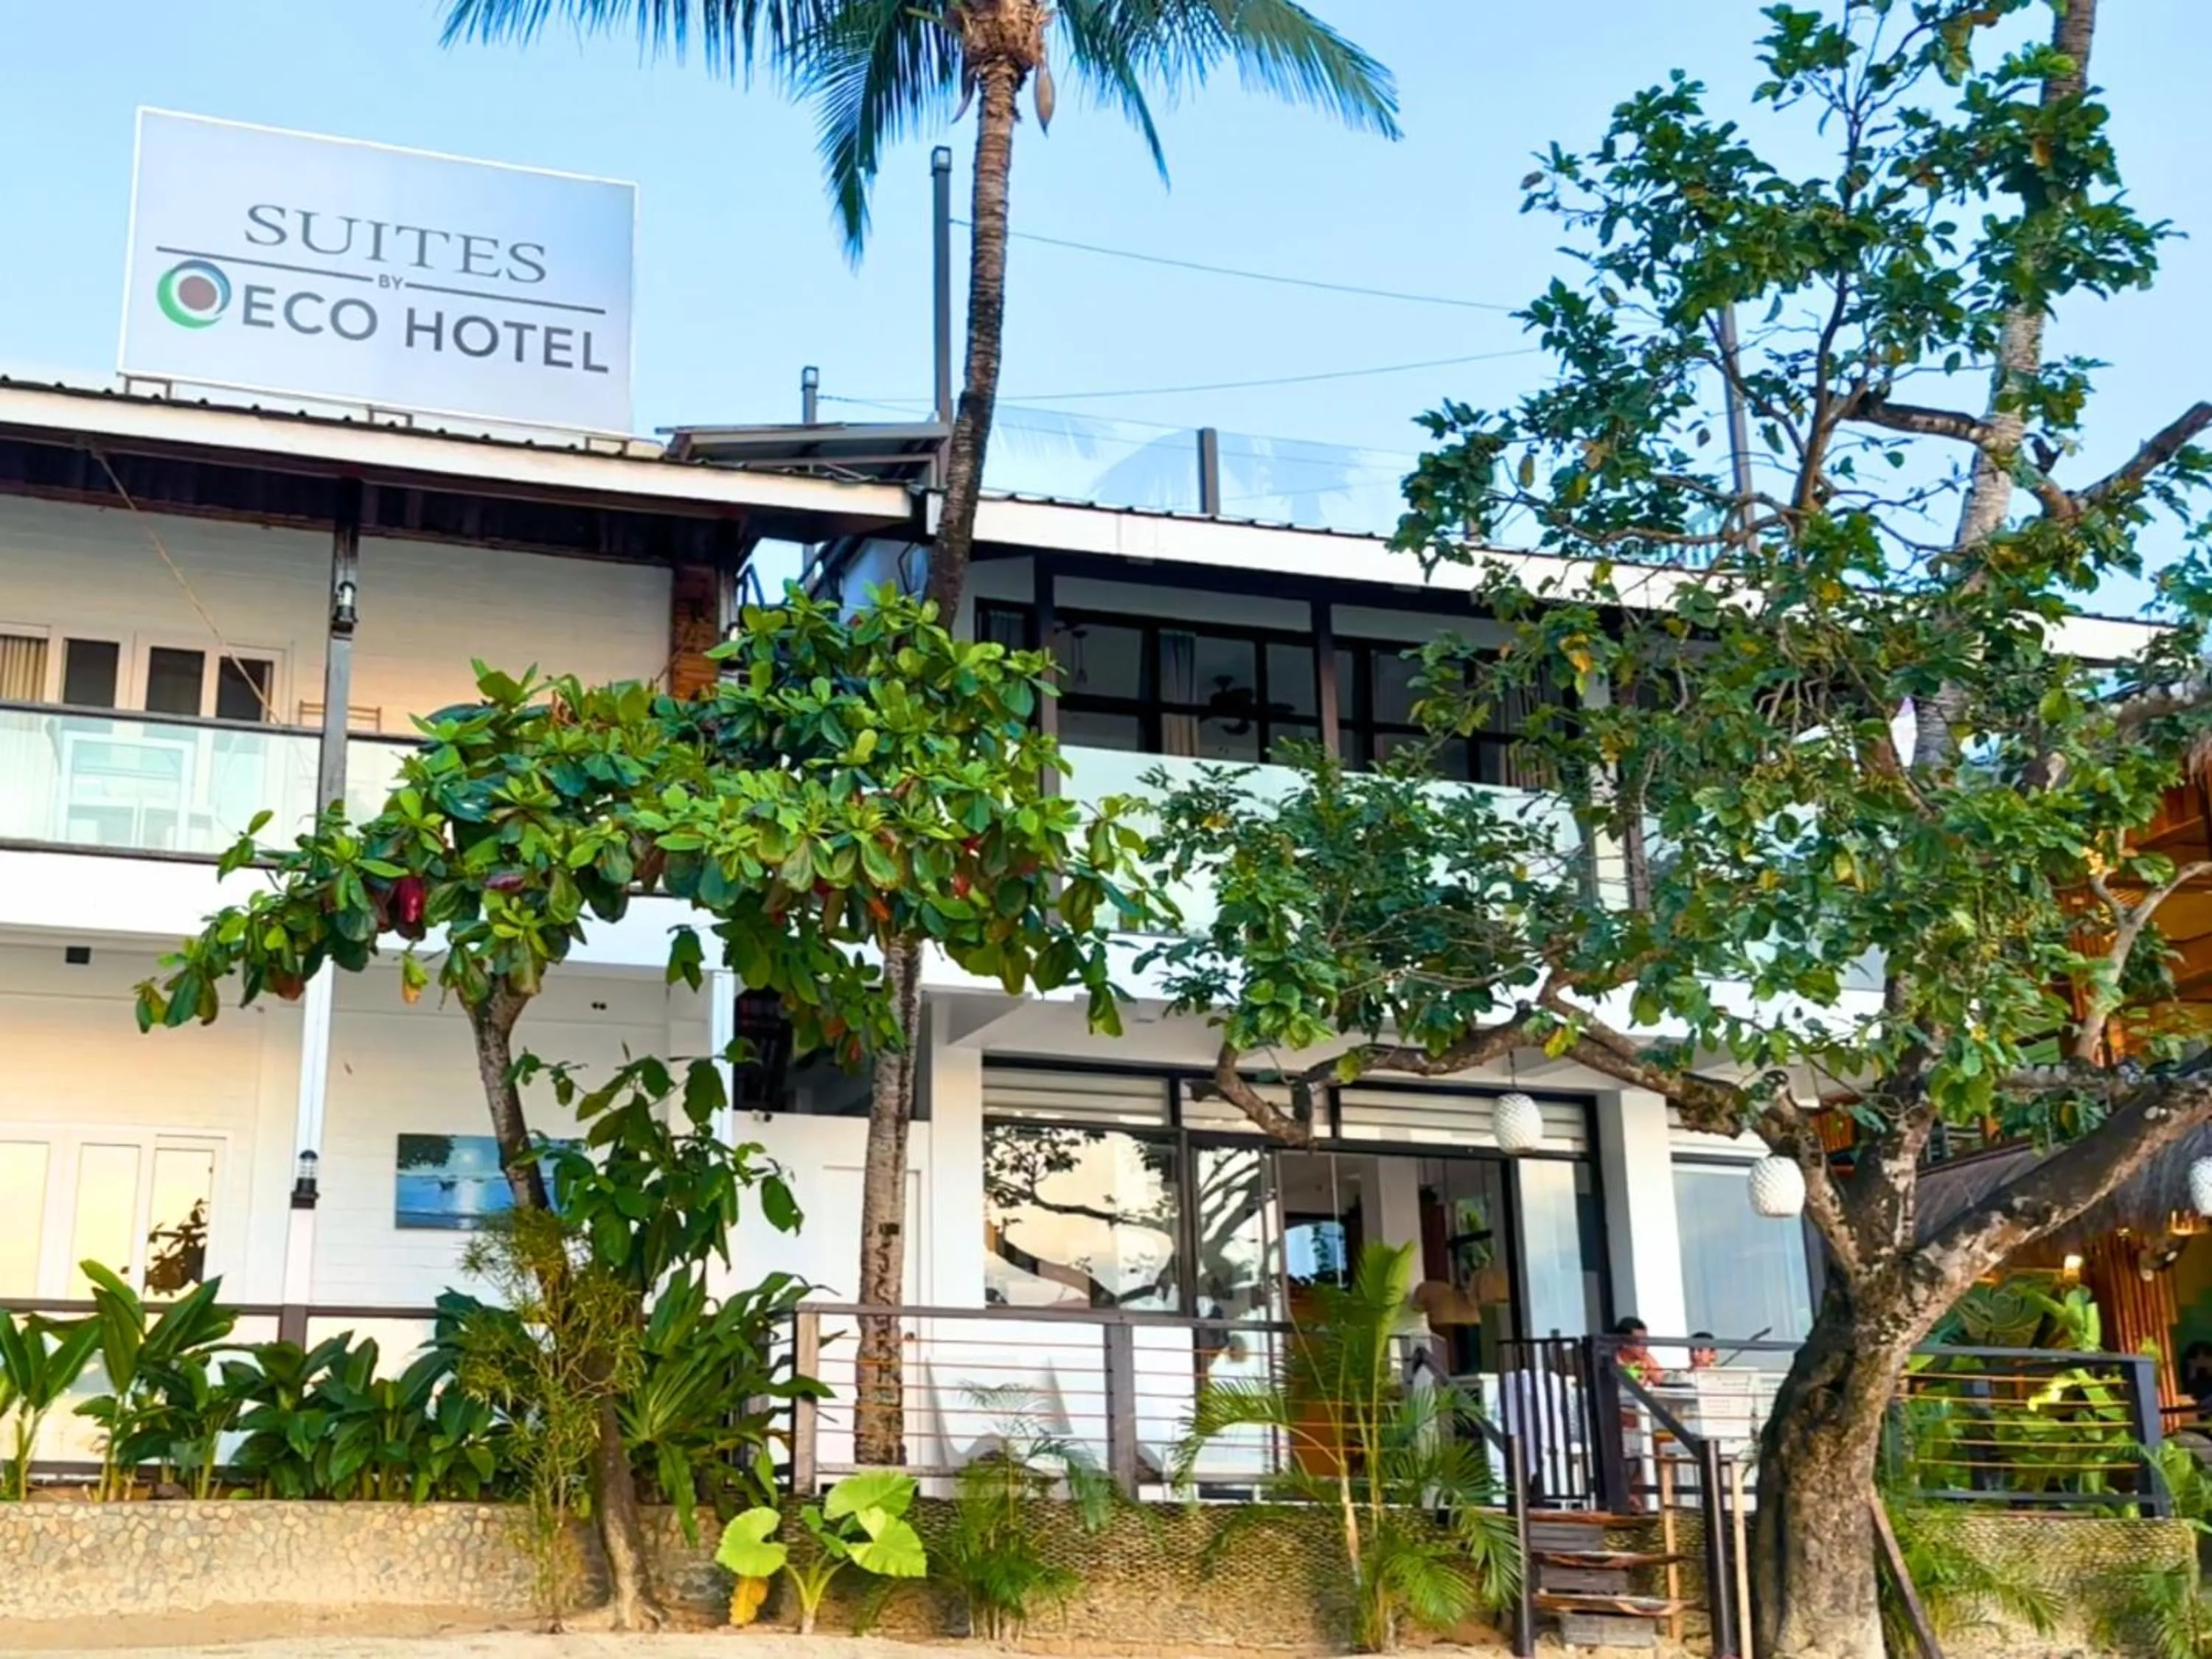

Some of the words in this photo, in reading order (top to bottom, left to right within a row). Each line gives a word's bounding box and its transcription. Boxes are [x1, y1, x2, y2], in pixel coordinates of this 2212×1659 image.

[244, 204, 546, 283] SUITES
[378, 274, 403, 290] BY
[242, 284, 378, 341] ECO
[405, 307, 609, 373] HOTEL
